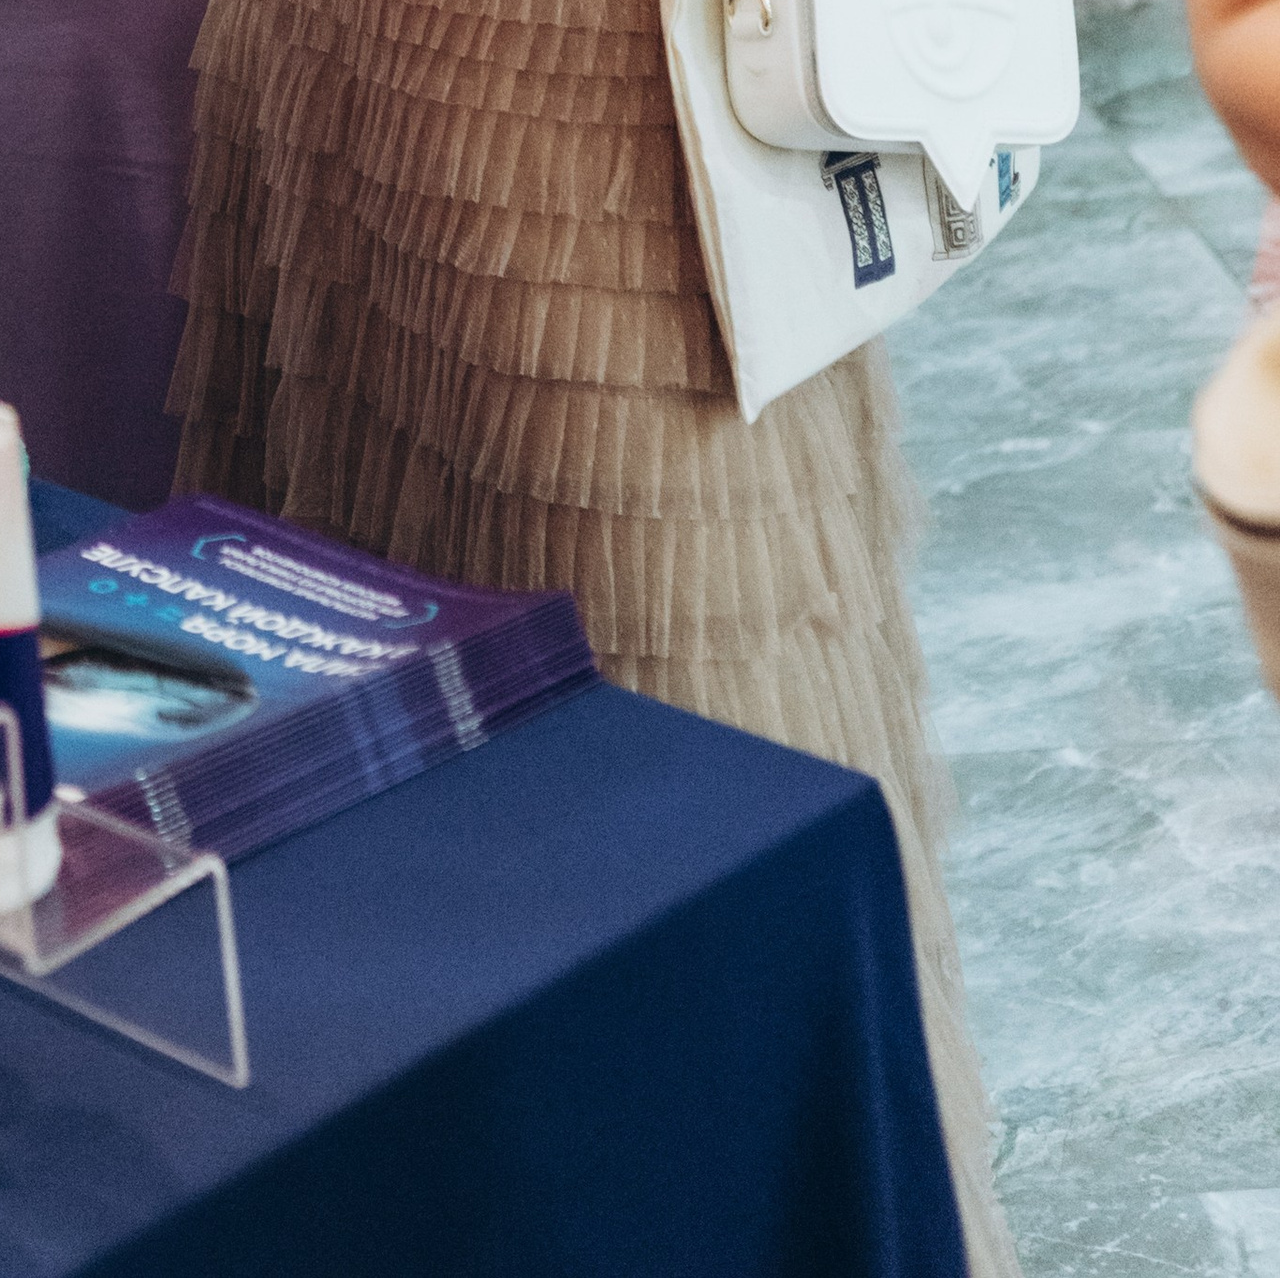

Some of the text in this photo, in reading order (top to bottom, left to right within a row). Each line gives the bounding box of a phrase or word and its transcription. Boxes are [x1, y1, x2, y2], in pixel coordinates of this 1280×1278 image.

[80, 541, 237, 612] КАПСУЛЕ
[181, 613, 288, 661] МОРЯ
[226, 601, 390, 661] КАЖДОЙ
